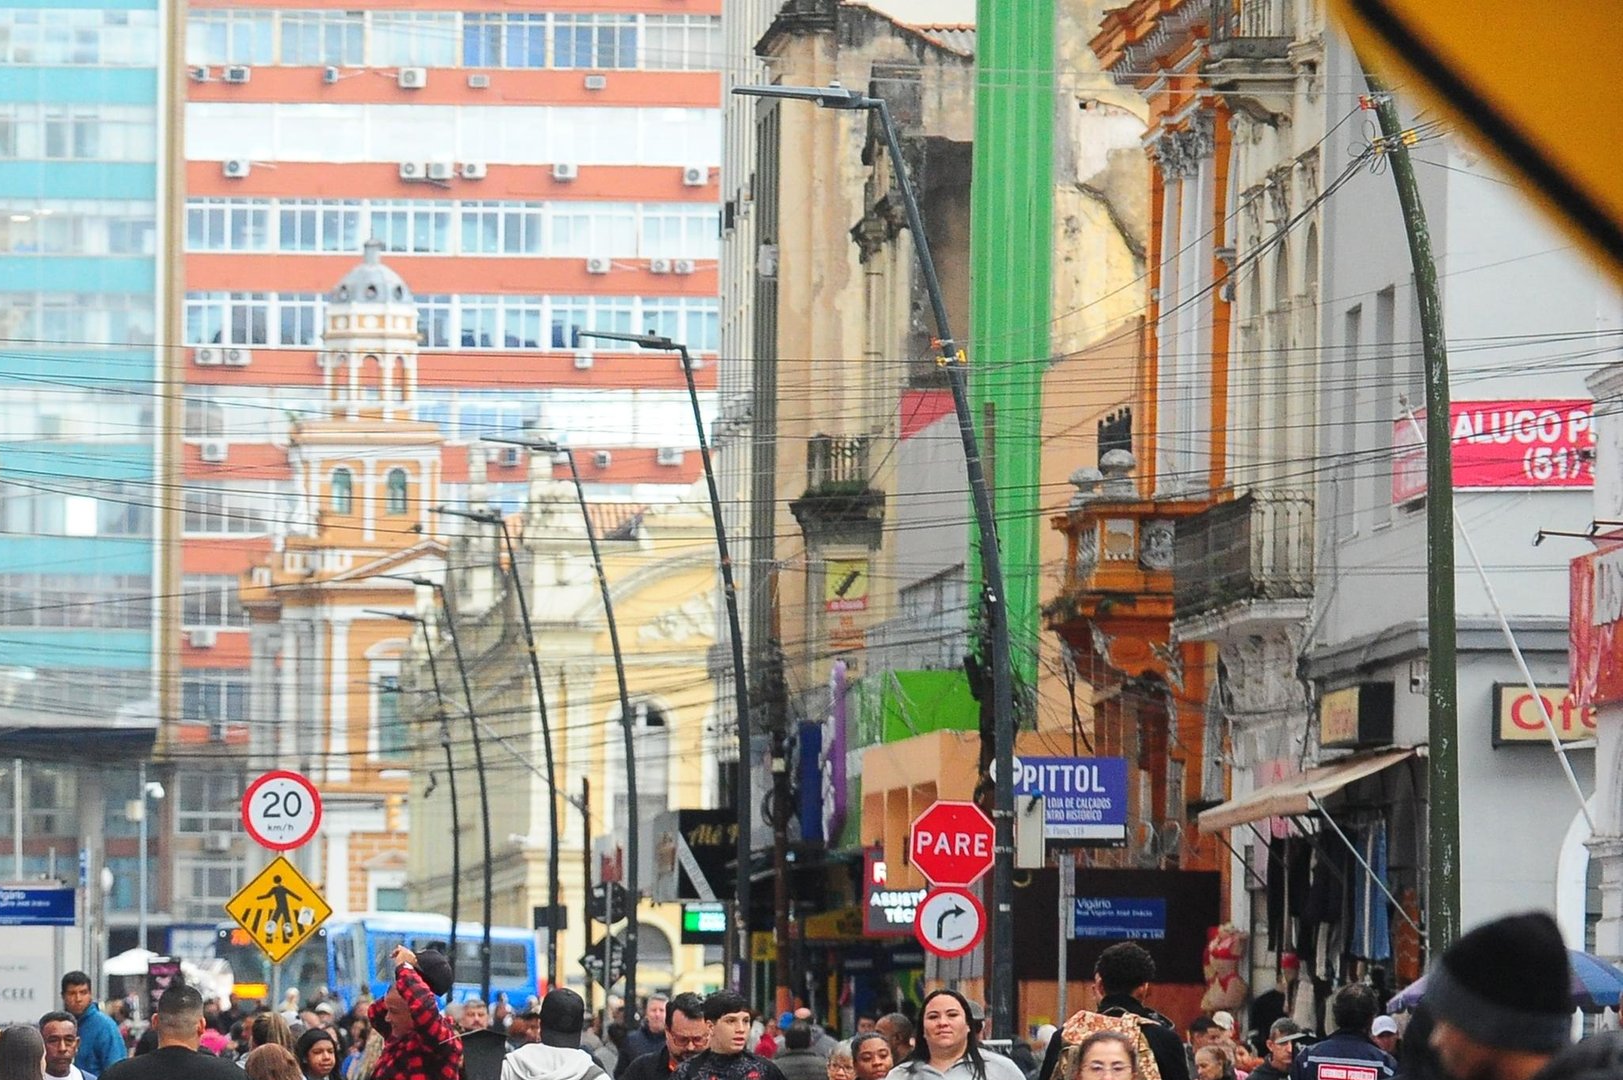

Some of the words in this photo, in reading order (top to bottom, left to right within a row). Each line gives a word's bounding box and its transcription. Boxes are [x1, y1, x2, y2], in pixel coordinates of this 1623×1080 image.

[1452, 410, 1562, 444] ALUGO
[1023, 764, 1106, 793] PITTOL
[262, 791, 302, 818] 20
[1046, 809, 1065, 821] NTRO
[267, 823, 295, 832] km/h
[917, 830, 989, 858] PARE
[1077, 898, 1112, 910] Vigário
